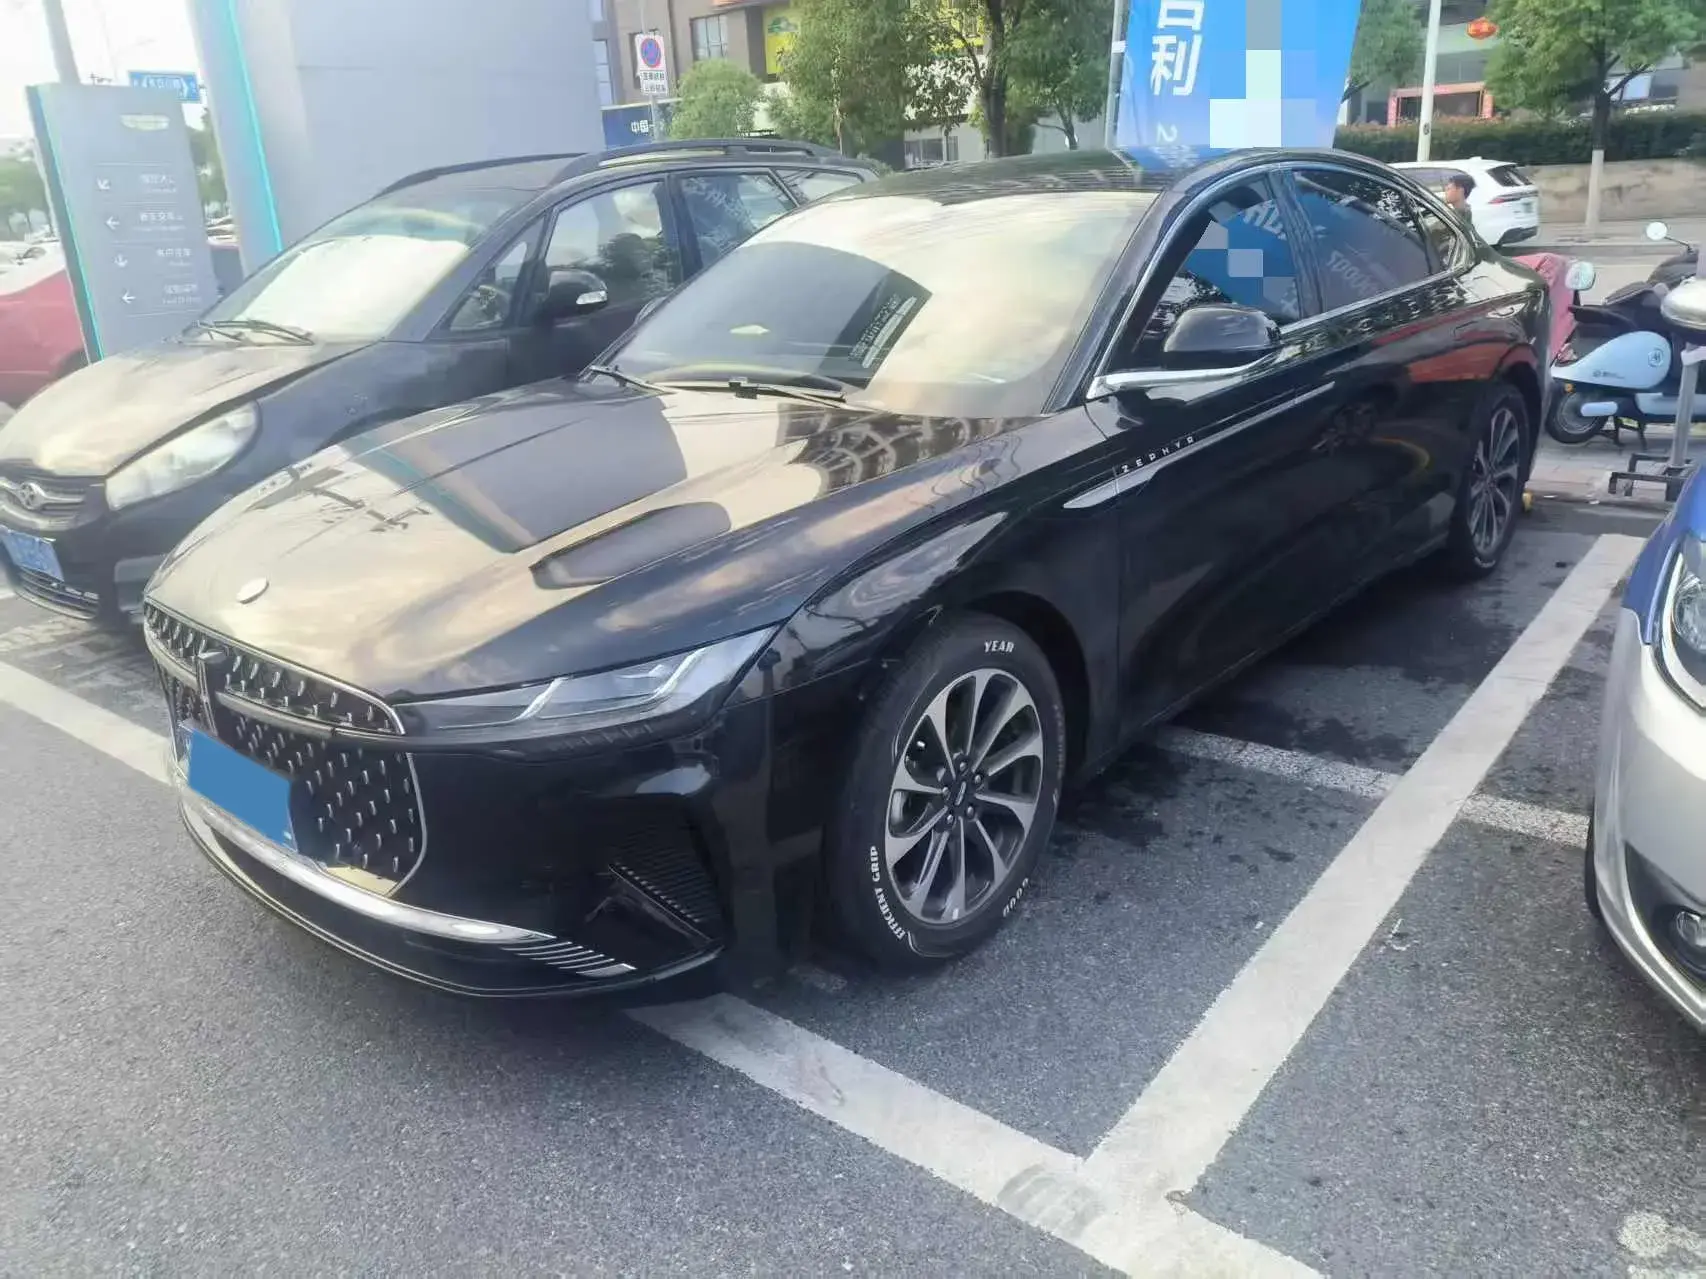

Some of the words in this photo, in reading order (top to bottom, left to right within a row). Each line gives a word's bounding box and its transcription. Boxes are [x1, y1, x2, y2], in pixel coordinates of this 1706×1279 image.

[1121, 435, 1194, 473] ZEPHYR
[984, 639, 1015, 653] YEAR
[870, 845, 880, 882] GRIP
